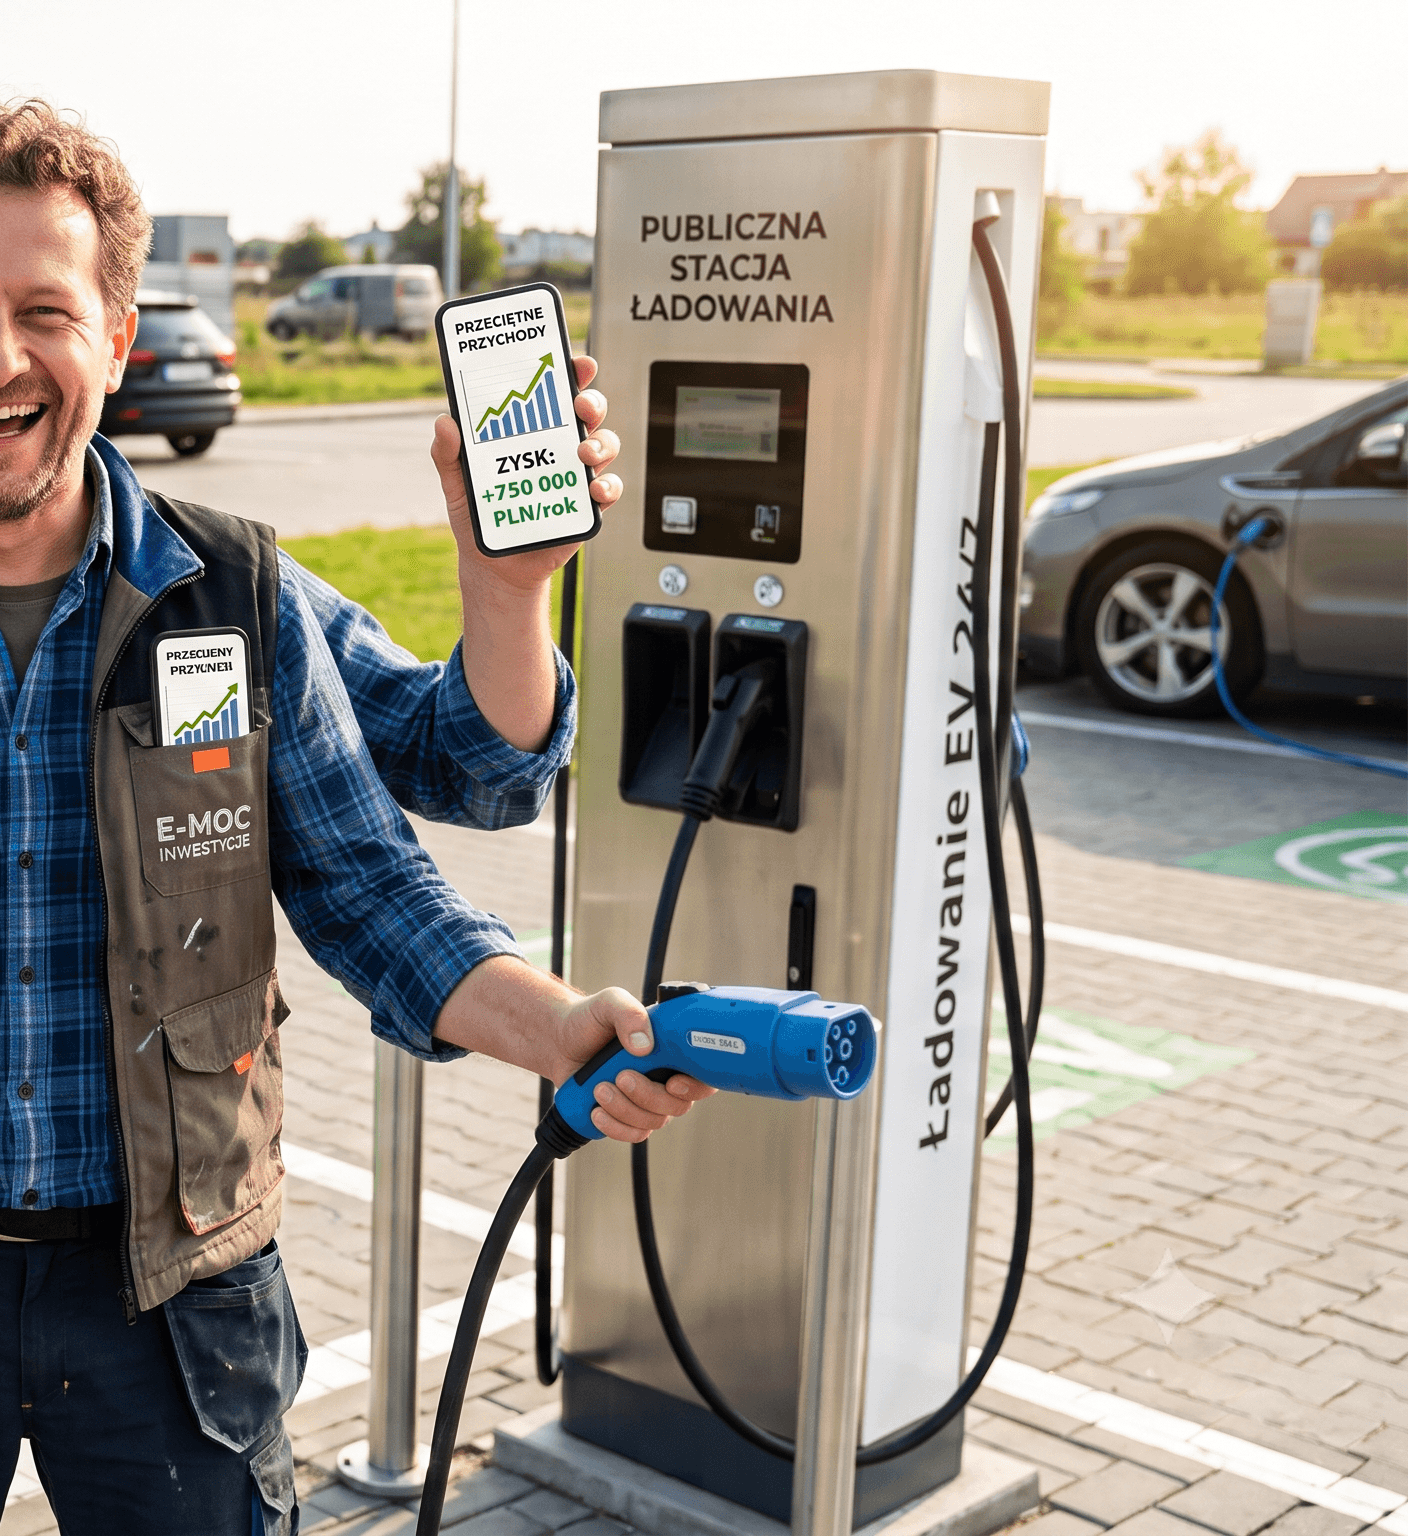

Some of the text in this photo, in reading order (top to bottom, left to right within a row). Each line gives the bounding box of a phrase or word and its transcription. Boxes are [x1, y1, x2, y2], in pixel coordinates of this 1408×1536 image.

[641, 211, 828, 243] PUBLICZNA
[670, 253, 792, 282] STACJA
[454, 306, 545, 336] PRZECIĘTNE
[630, 293, 835, 323] ŁADOWANIA
[458, 324, 547, 353] PRZYCHODY
[495, 448, 556, 475] ZYSK:
[481, 470, 578, 503] +750 000
[493, 496, 579, 528] PLN/rok
[944, 680, 975, 767] EV
[156, 805, 252, 842] E-MOC
[159, 833, 251, 862] INWESTYCJE
[919, 790, 970, 1152] Ładowanie
